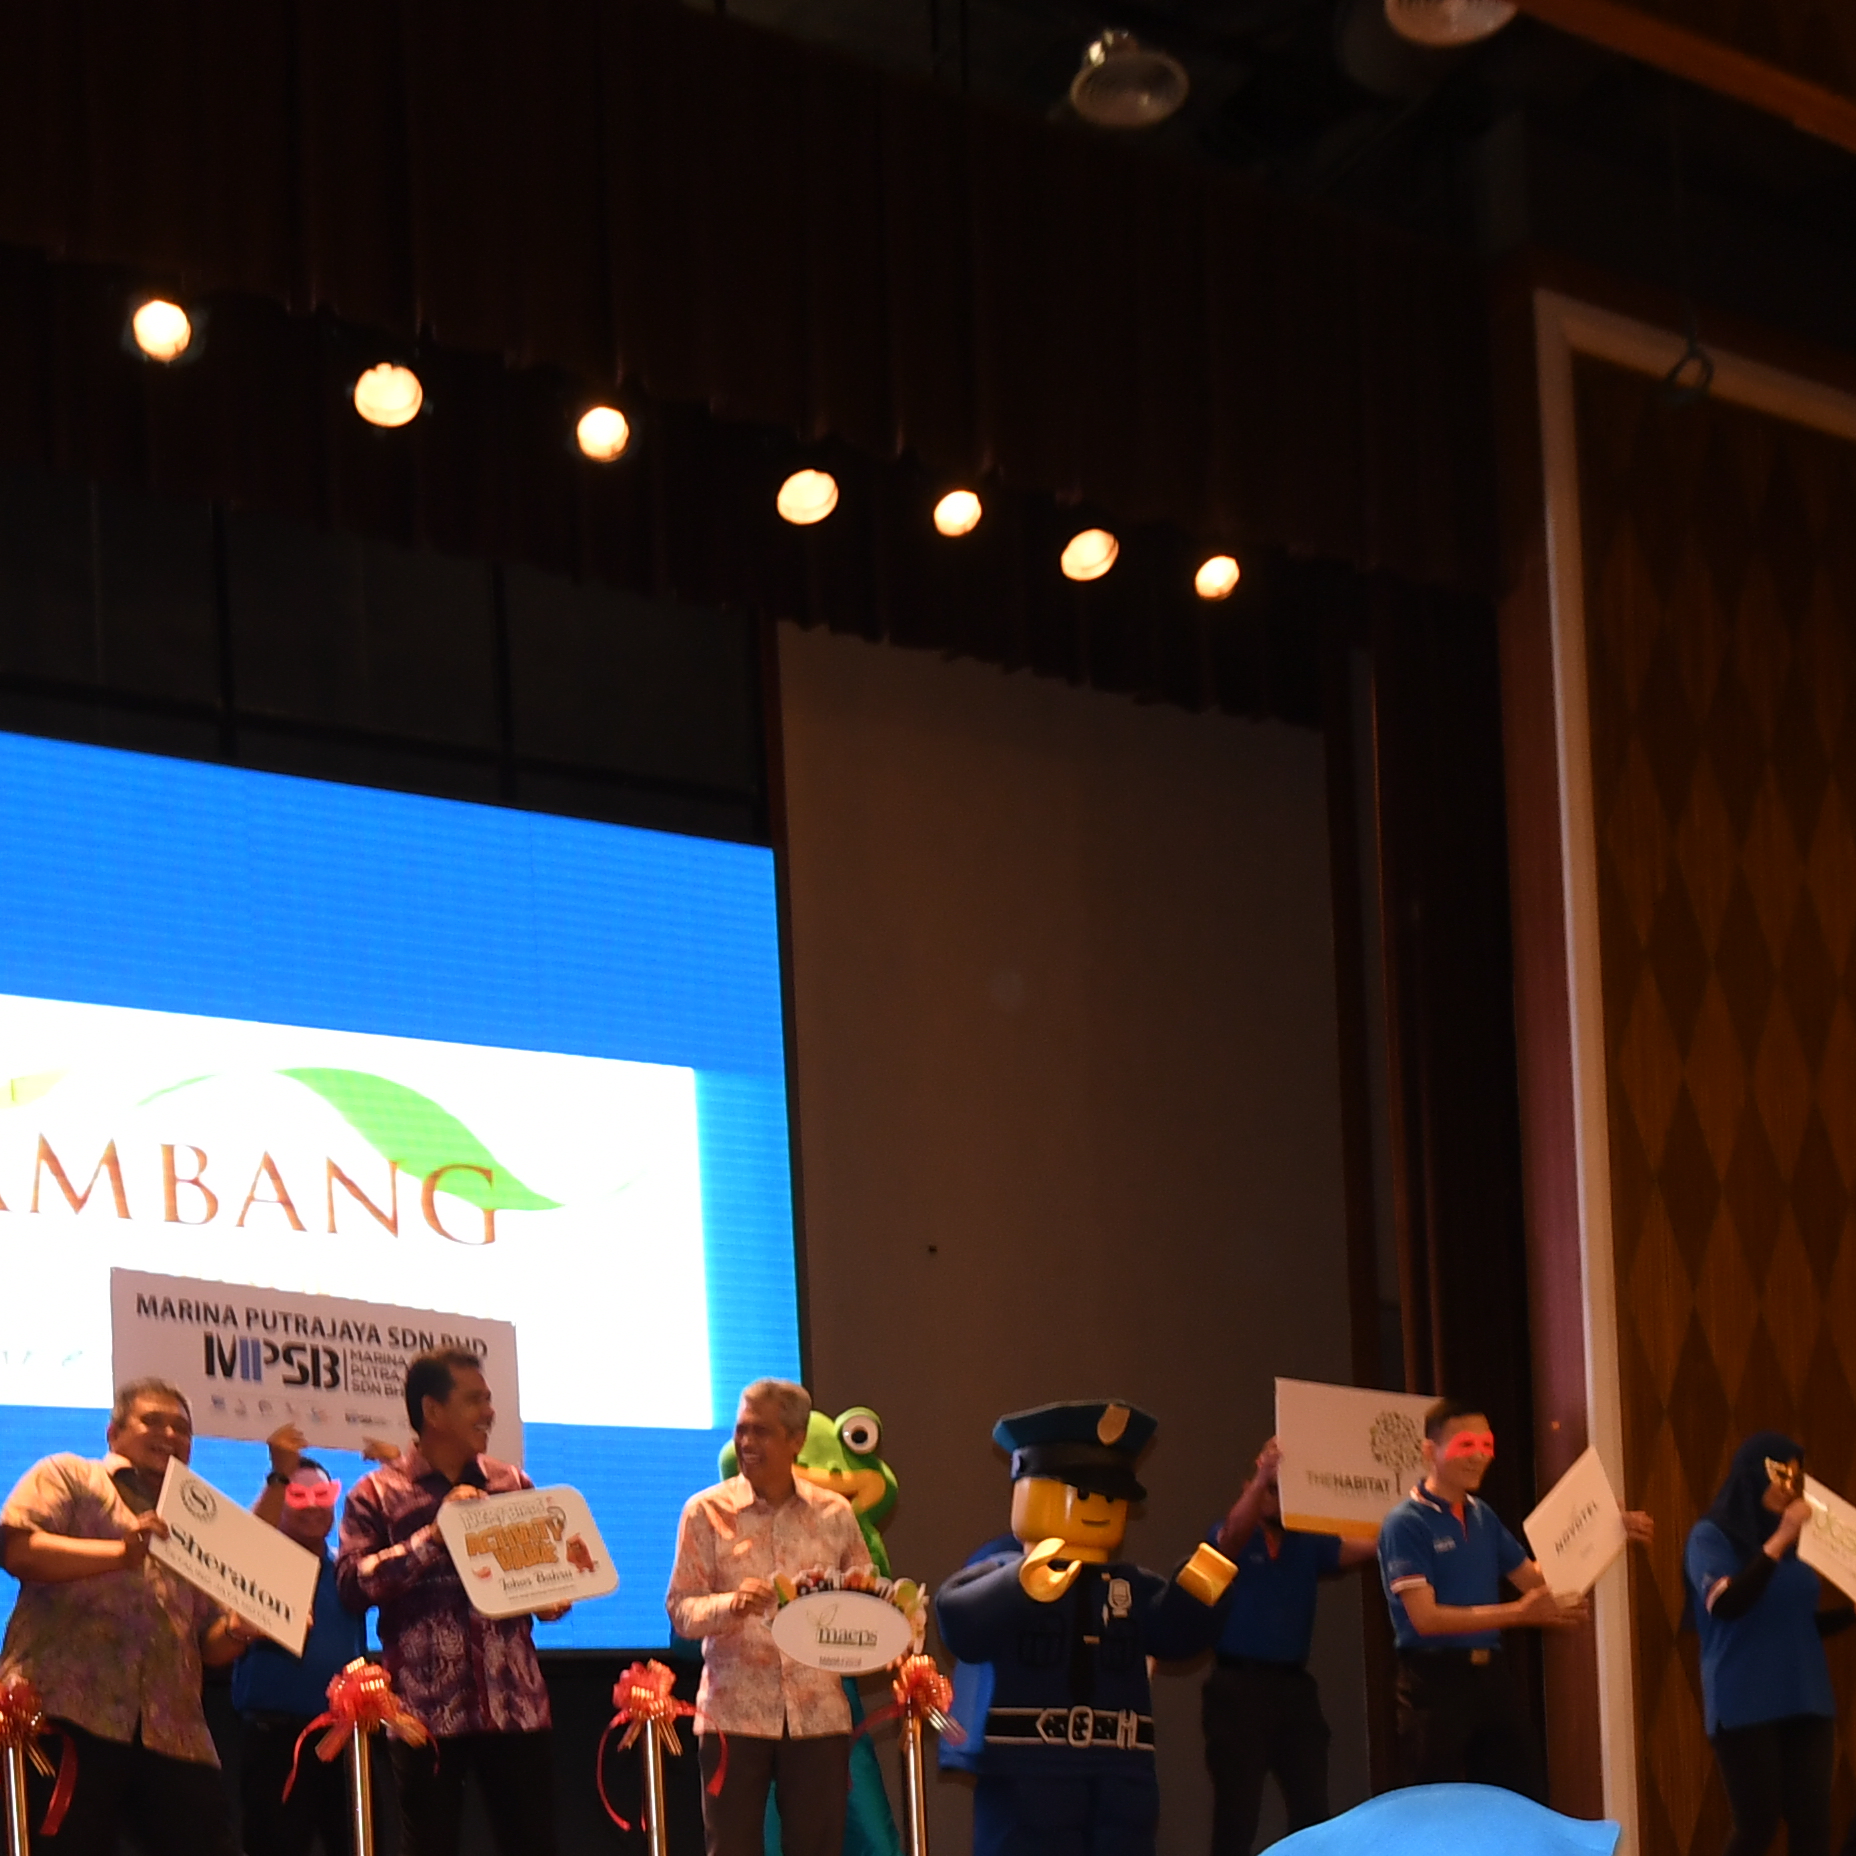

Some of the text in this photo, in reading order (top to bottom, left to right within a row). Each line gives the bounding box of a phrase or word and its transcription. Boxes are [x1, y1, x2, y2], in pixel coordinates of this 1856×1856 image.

[136, 1292, 238, 1328] MARINA
[246, 1306, 382, 1345] PUTRAJAYA
[388, 1326, 434, 1350] SDN
[205, 1331, 341, 1391] MPSB
[464, 1515, 566, 1557] ACTIVITY
[494, 1541, 559, 1571] PARK
[1553, 1499, 1599, 1556] NOVOTEL
[170, 1522, 292, 1624] Sheraton
[817, 1626, 878, 1647] maeps
